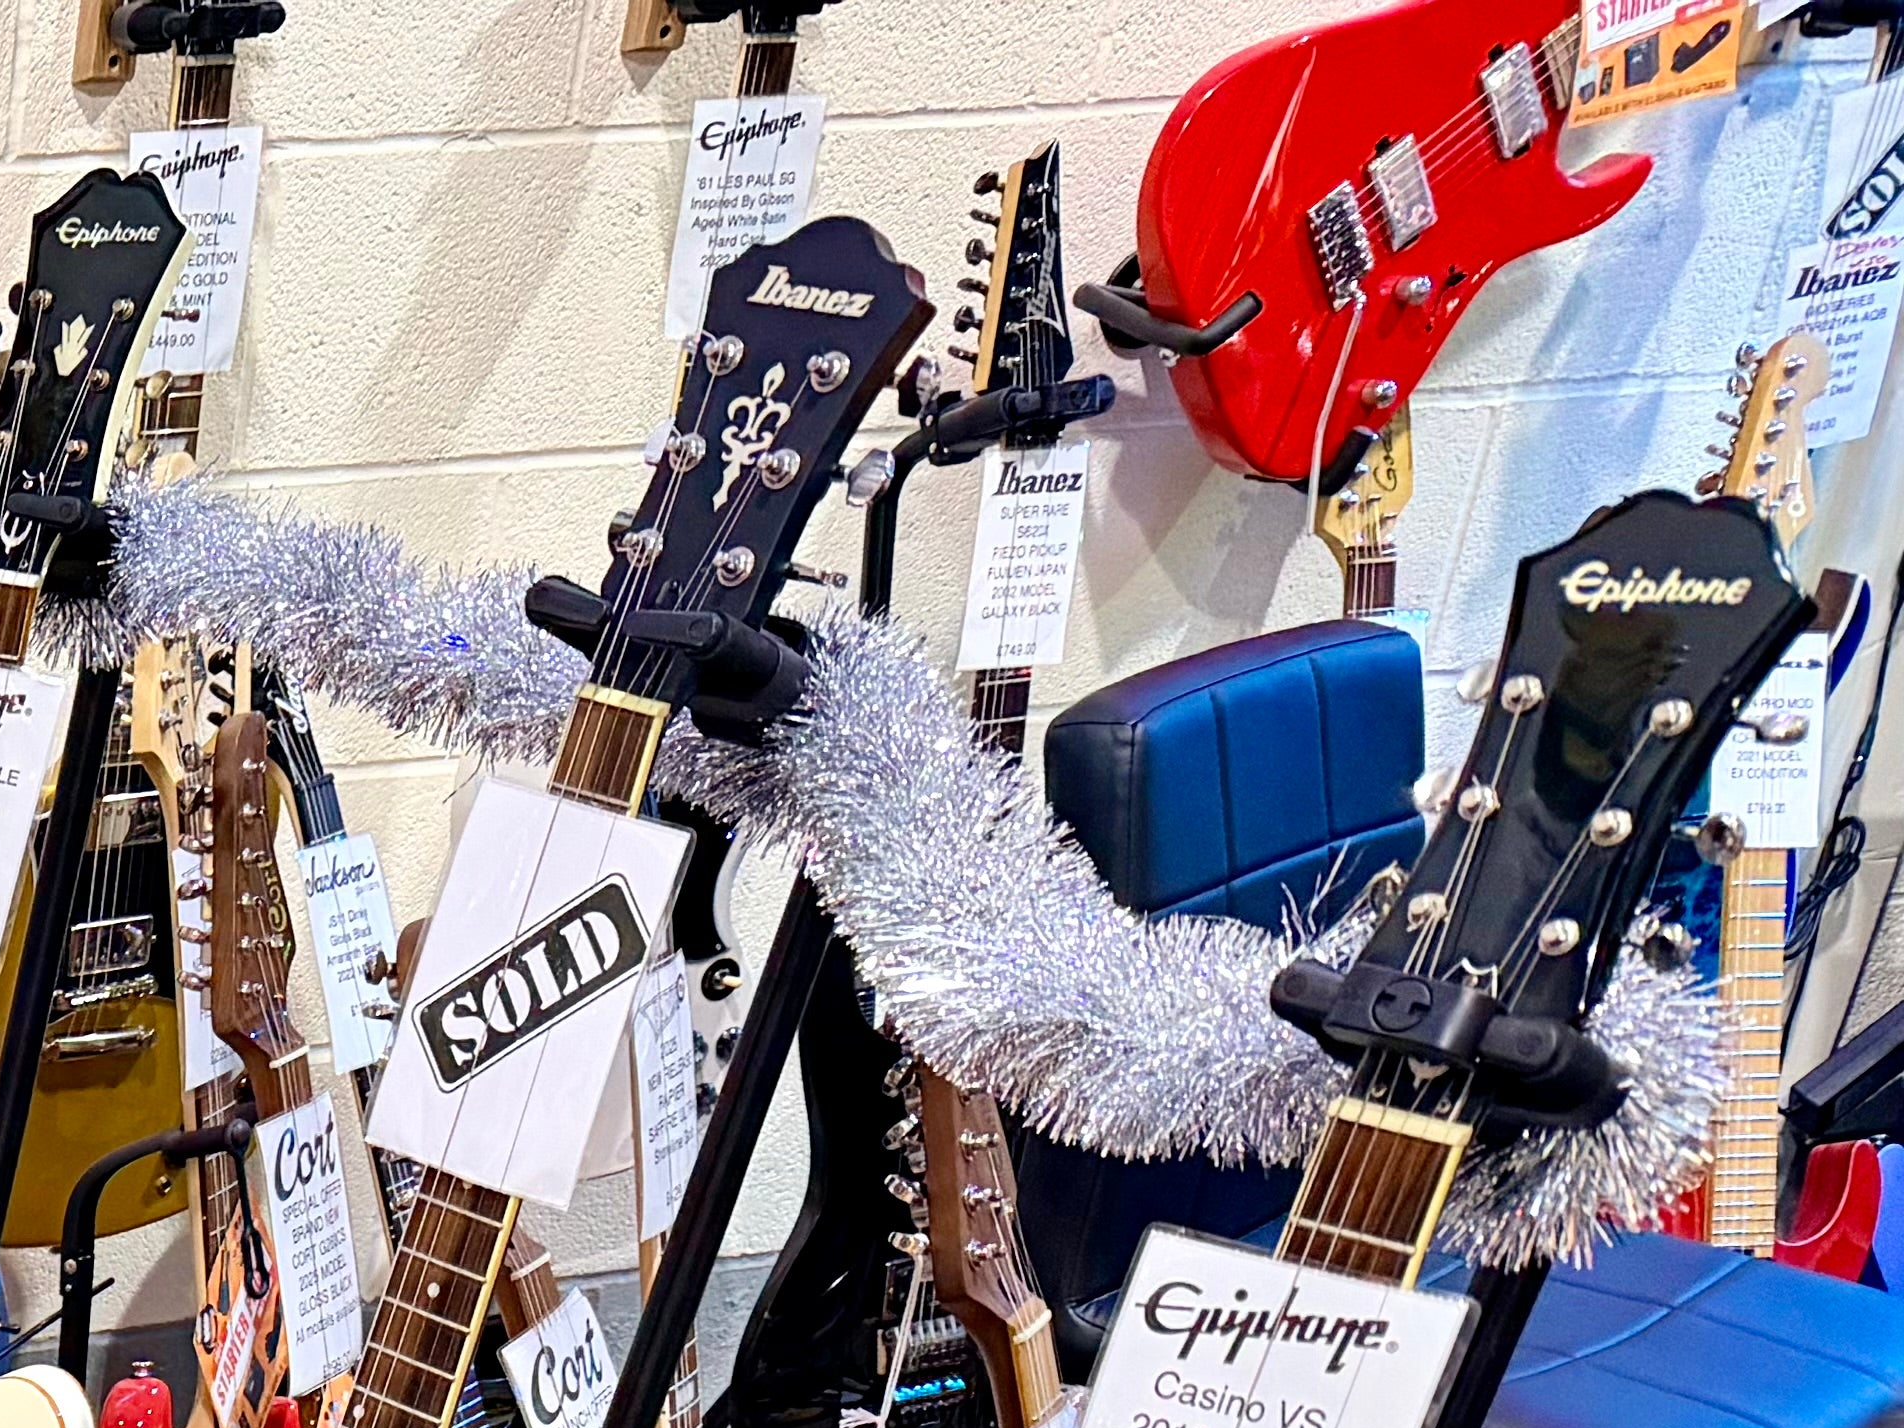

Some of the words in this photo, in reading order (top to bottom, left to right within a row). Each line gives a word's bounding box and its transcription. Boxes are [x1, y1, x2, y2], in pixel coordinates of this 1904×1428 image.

[695, 109, 802, 160] Epiphone
[55, 216, 160, 249] Epiphone
[746, 265, 874, 317] Ibanez
[1788, 261, 1902, 301] Ibanez
[992, 461, 1083, 496] Ibanez
[1561, 562, 1752, 613] Epiphone
[439, 909, 622, 1069] SOLD
[1136, 1282, 1390, 1374] Epiphone
[1154, 1370, 1267, 1424] Casino
